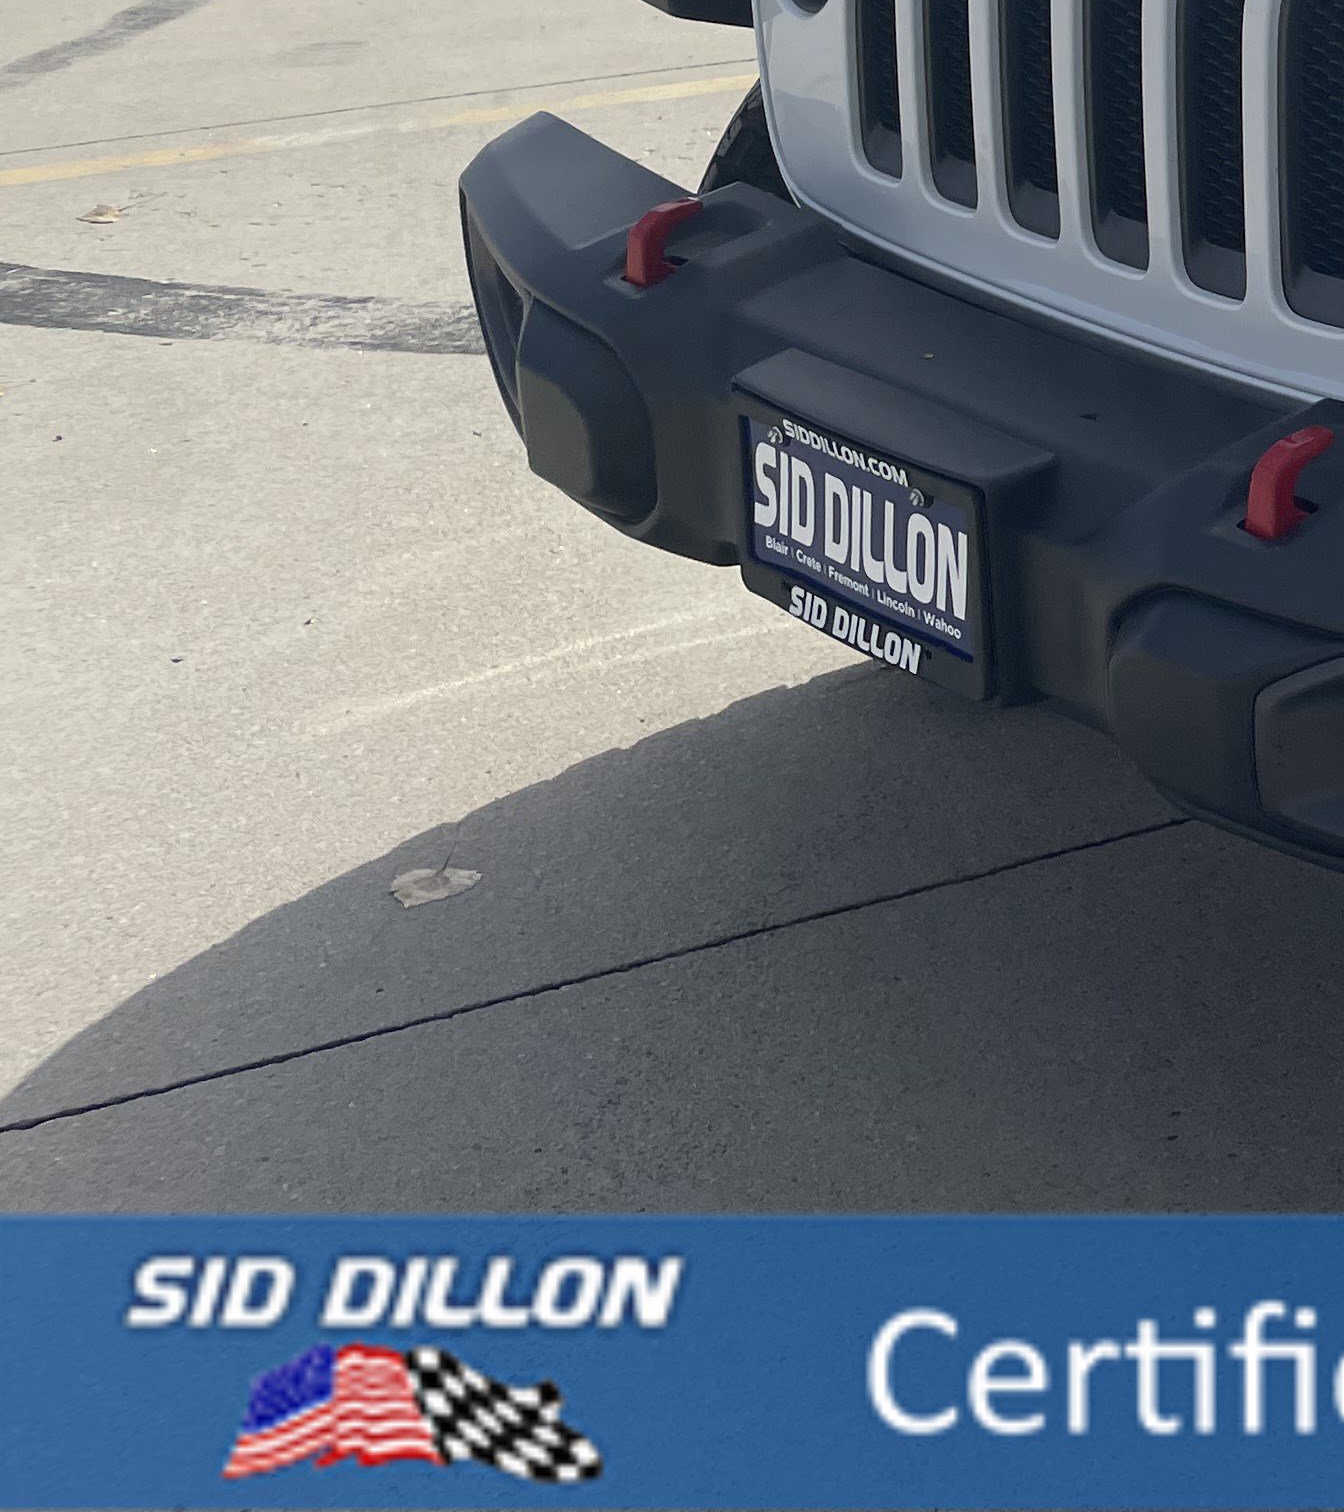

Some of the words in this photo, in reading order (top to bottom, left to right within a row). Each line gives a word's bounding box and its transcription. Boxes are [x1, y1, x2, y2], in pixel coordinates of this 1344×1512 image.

[782, 418, 909, 488] SIDDILLON.COM
[754, 441, 816, 547] SID
[824, 472, 968, 621] DILLON
[765, 535, 789, 557] Blair
[795, 548, 822, 574] Crete
[828, 566, 870, 597] Fremont
[877, 586, 915, 618] Lincoln
[923, 609, 962, 640] Wahoo
[788, 585, 828, 629] SID
[832, 606, 922, 675] DILLON
